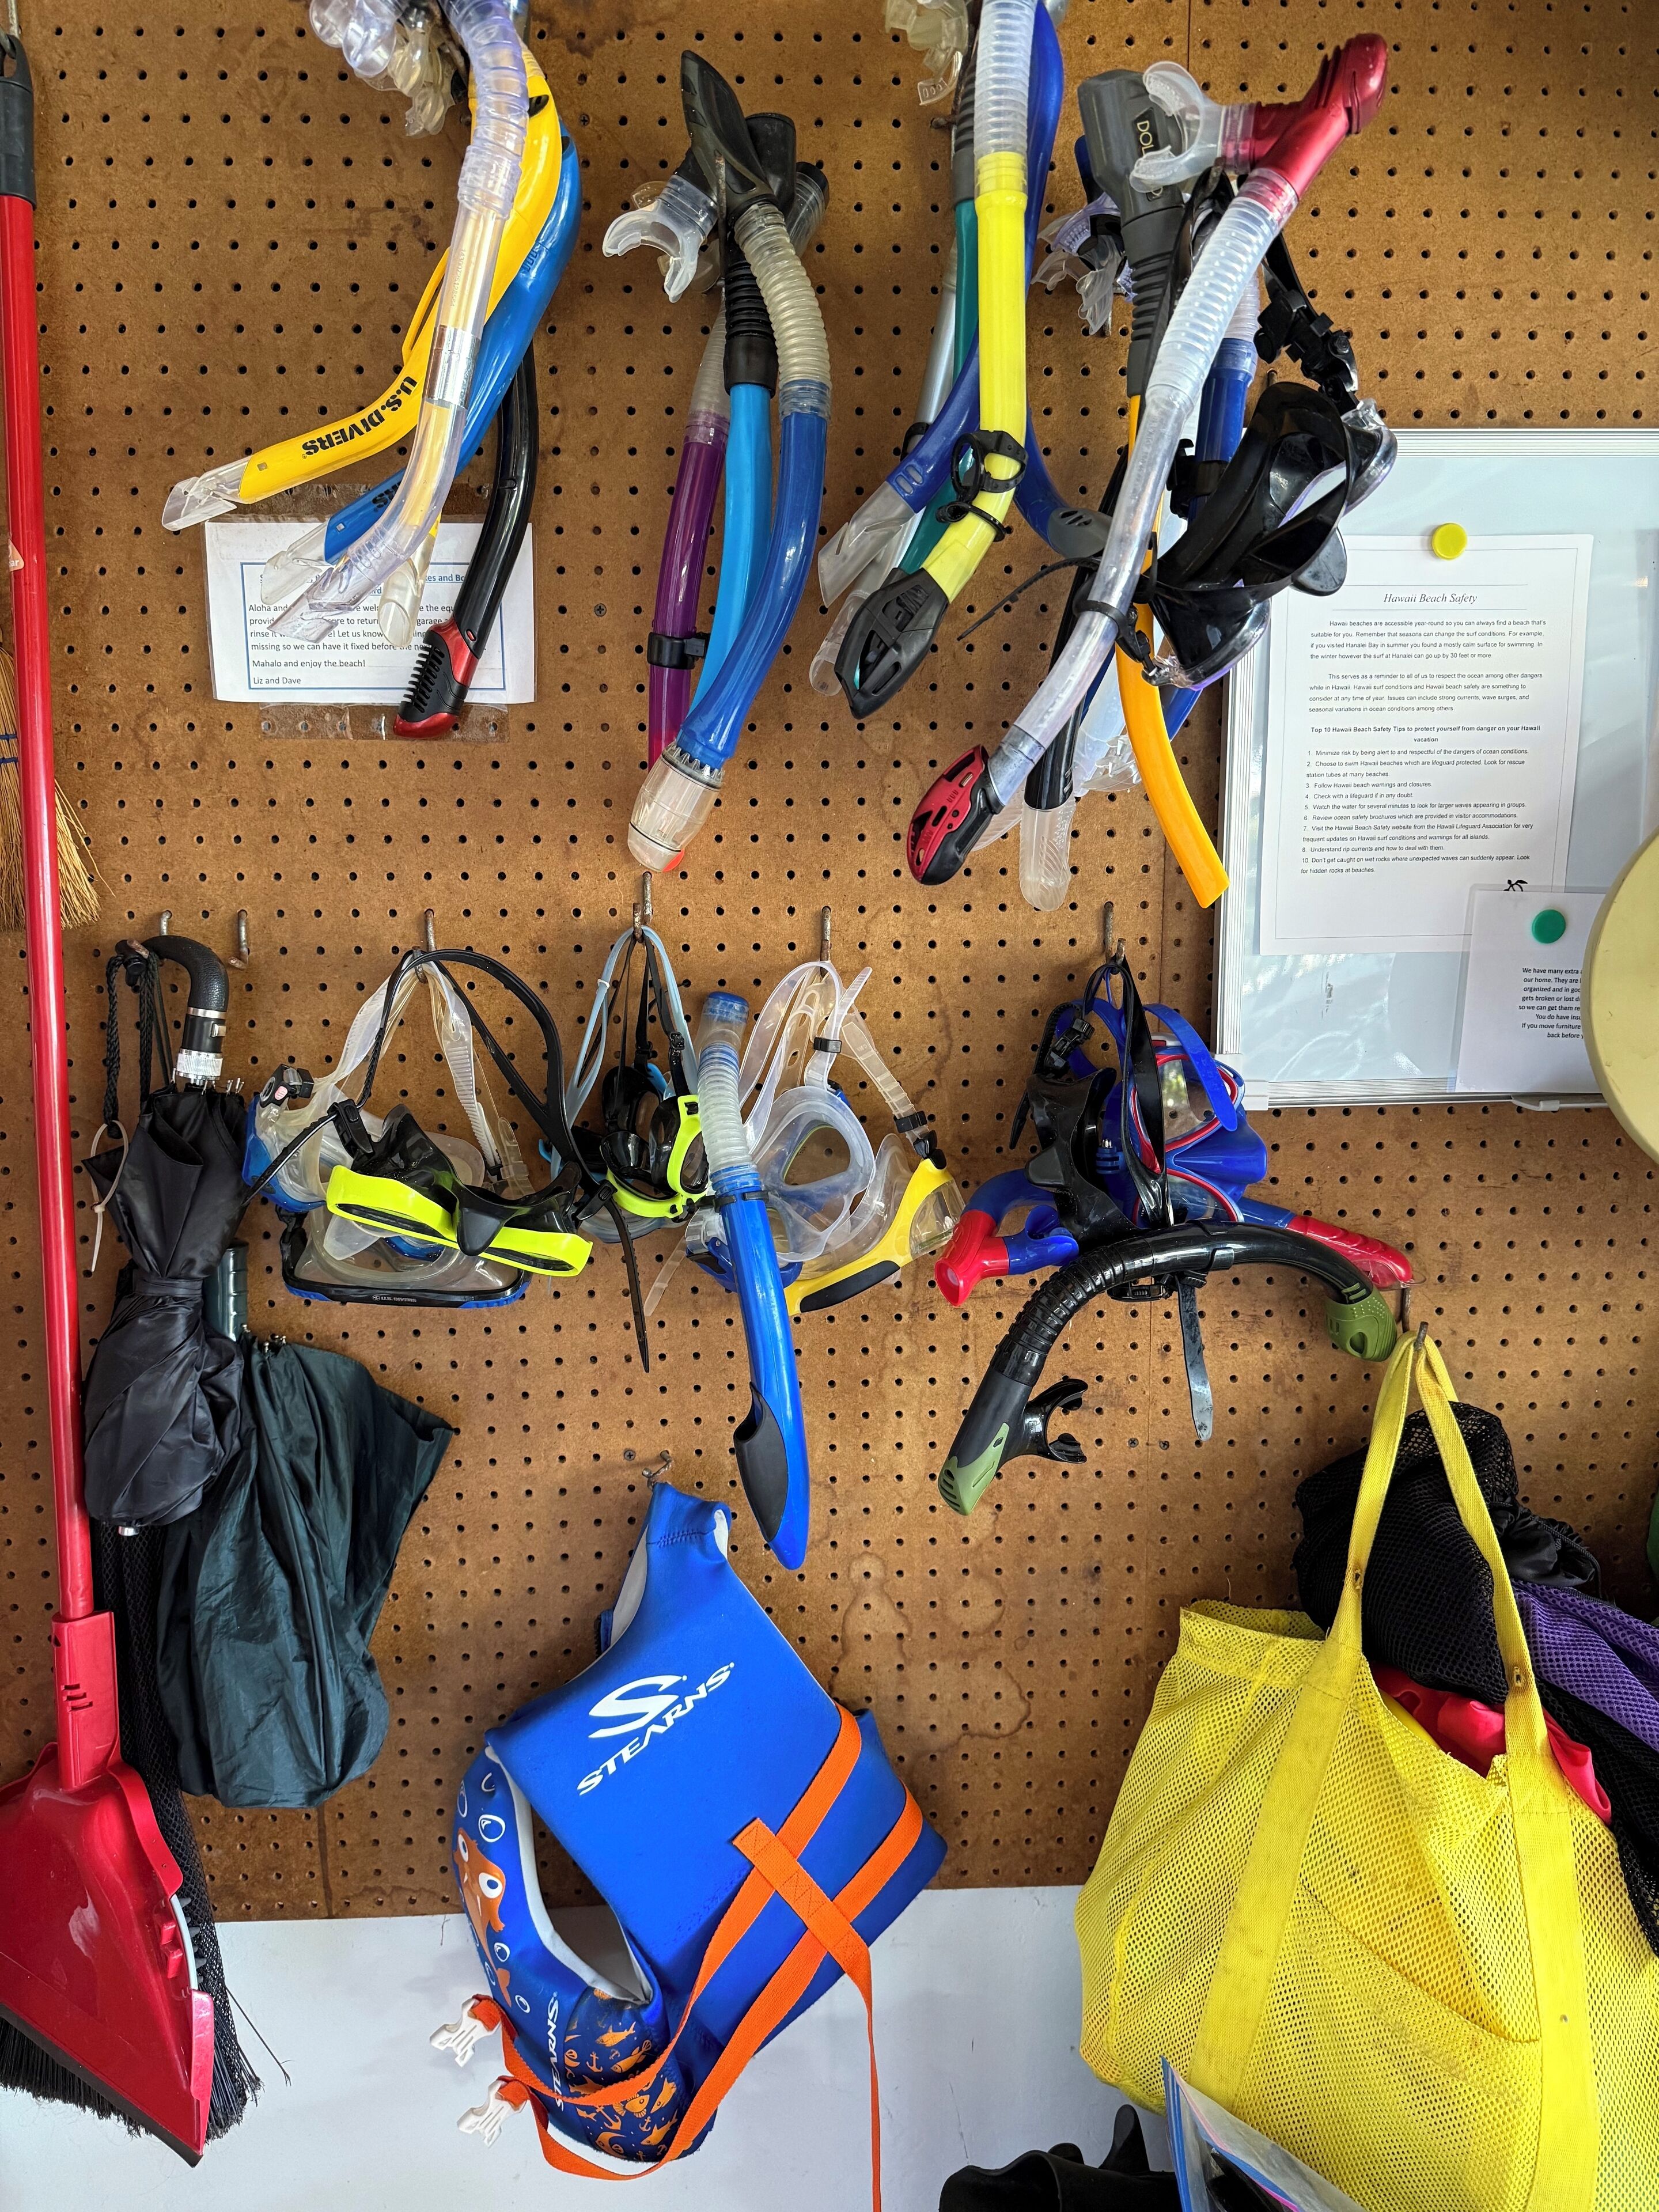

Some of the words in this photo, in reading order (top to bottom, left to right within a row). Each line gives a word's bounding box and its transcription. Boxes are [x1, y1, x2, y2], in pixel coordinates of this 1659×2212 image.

[1384, 594, 1416, 602] Hawaii
[1419, 593, 1447, 602] Beach
[1449, 593, 1477, 604] Safety
[426, 604, 439, 612] the
[372, 642, 397, 650] before
[301, 660, 321, 668] enjoy
[577, 1664, 733, 1796] STEARNS
